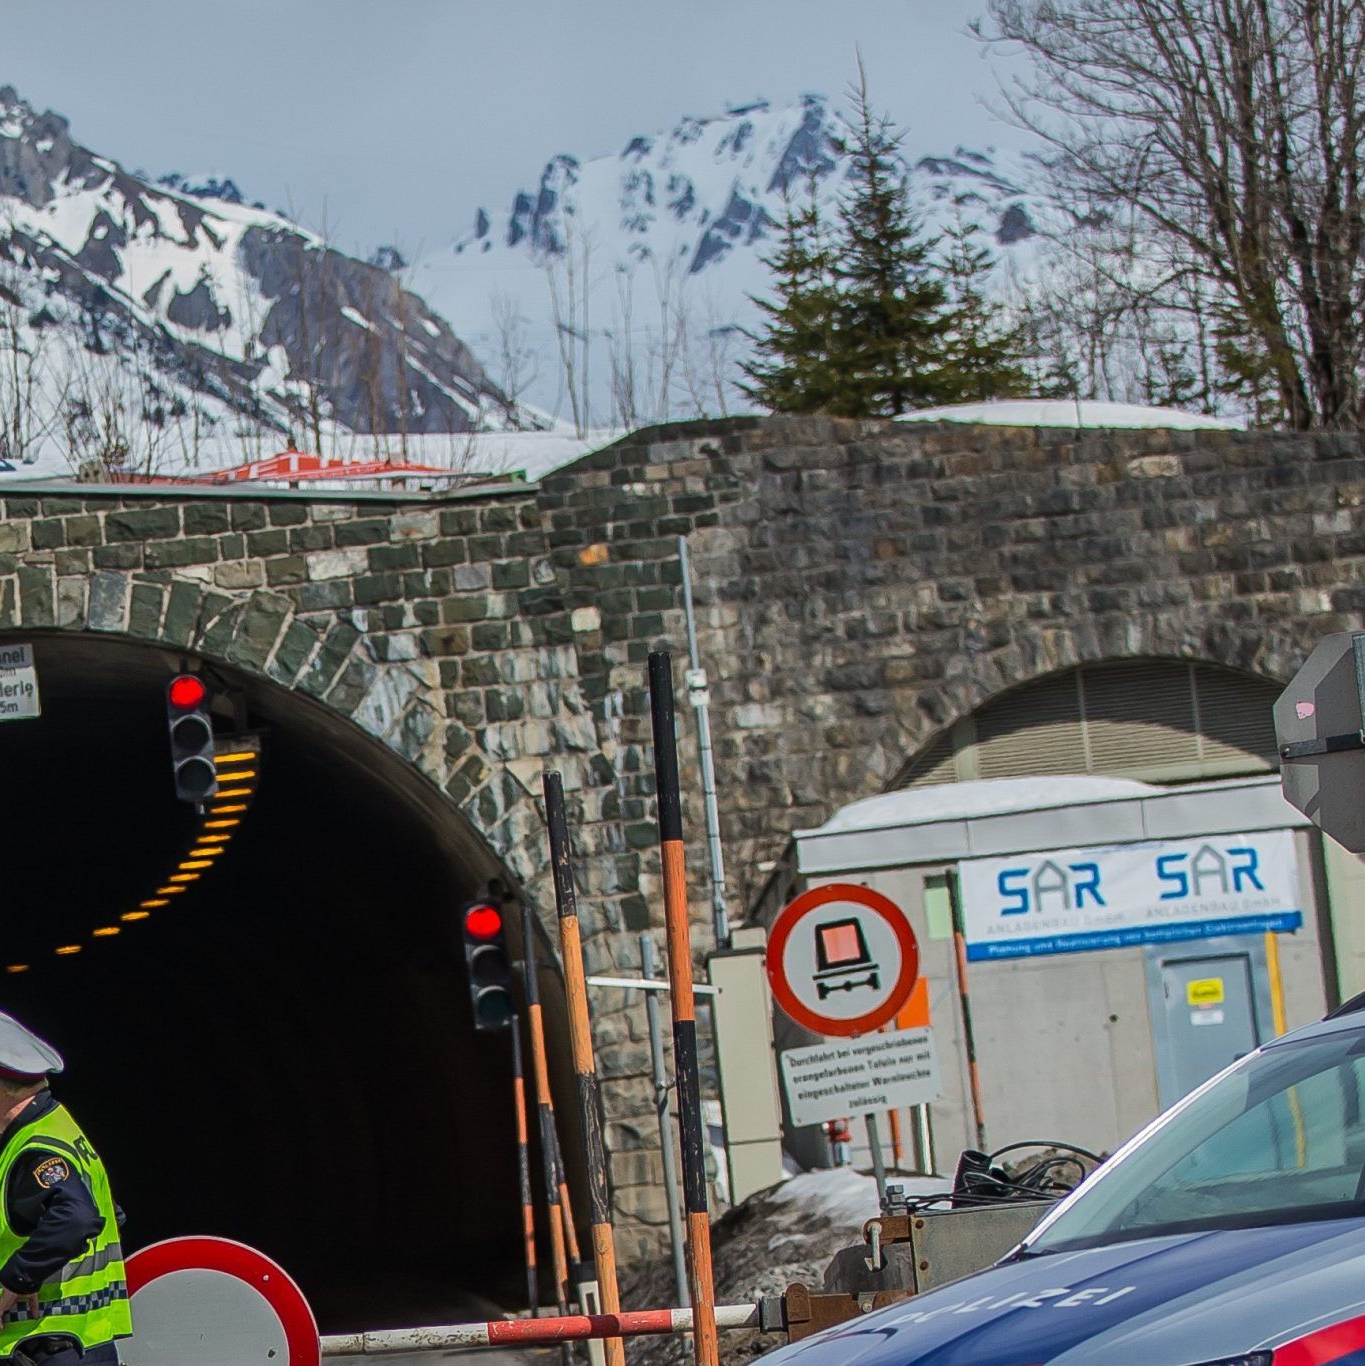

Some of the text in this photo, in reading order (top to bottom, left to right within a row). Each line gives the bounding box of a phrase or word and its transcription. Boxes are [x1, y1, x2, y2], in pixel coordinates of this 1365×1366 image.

[998, 860, 1107, 917] SAR
[1156, 845, 1265, 900] SAR
[872, 1286, 1136, 1333] POLIZEI
